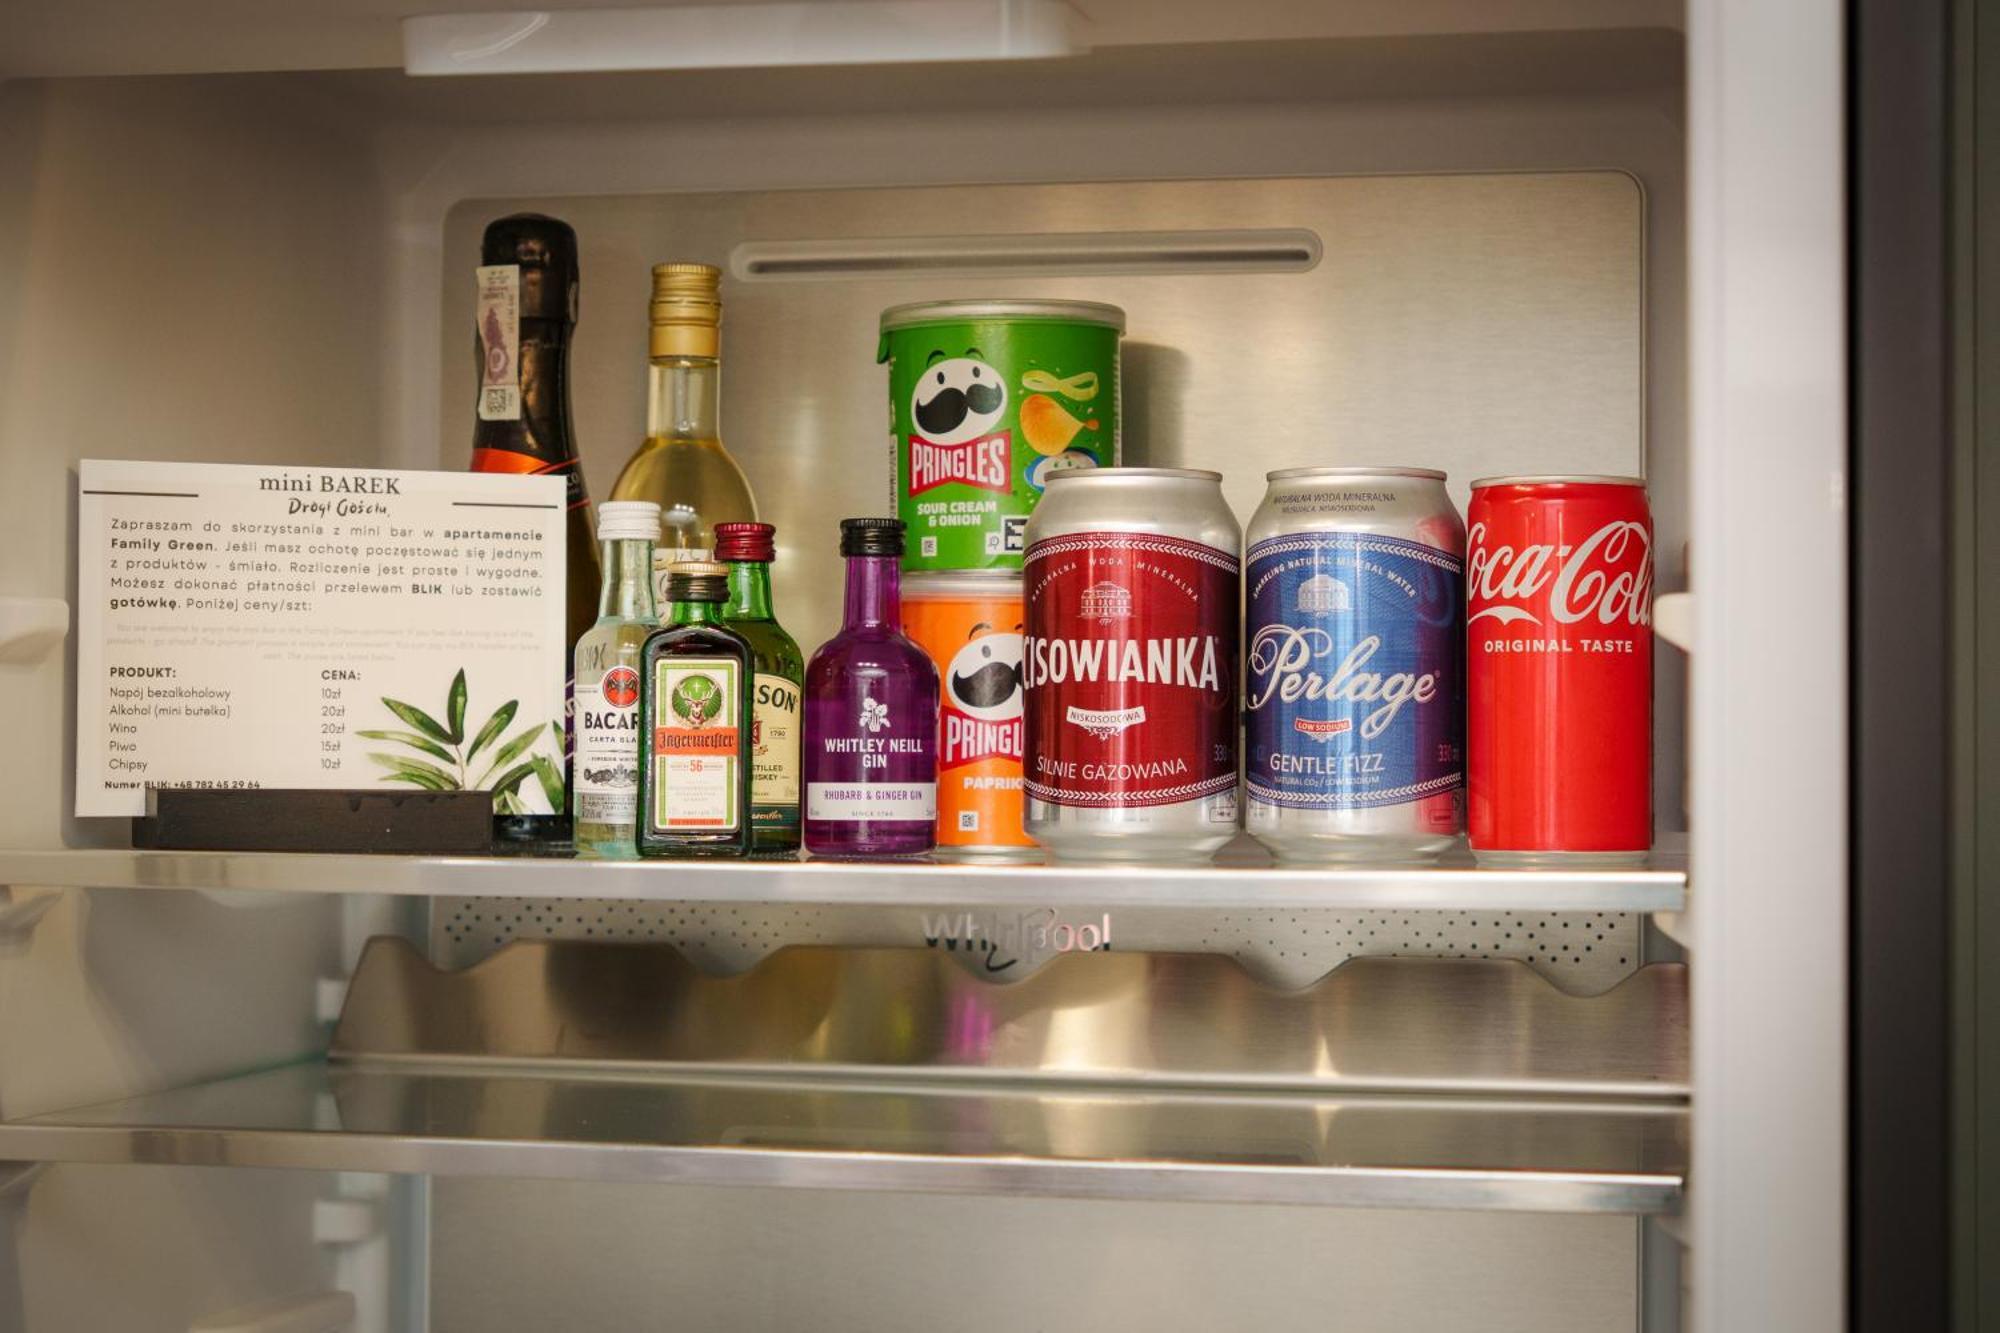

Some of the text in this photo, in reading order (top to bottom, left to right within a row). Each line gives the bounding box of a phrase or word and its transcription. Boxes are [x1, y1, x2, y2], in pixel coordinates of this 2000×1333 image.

[912, 437, 1004, 490] PRINGLES
[259, 474, 400, 494] mini BAREK
[1314, 493, 1340, 502] WODA
[1344, 492, 1396, 502] MINERALNA
[918, 500, 997, 515] SOUR CREAM
[928, 514, 981, 526] & ONION
[111, 518, 192, 533] Zapraszam
[203, 522, 221, 532] do
[232, 522, 324, 536] skorzystania
[352, 524, 380, 536] mini
[391, 526, 415, 536] bar
[444, 528, 542, 541] apartamencie
[111, 538, 542, 560] Family Green. Jeśli masz ochotę poczęstować się jednym
[110, 560, 118, 569] z
[126, 558, 207, 573] produktów
[229, 560, 282, 572] śmiało.
[290, 562, 370, 574] Rozliczenie
[378, 562, 404, 577] jest
[412, 565, 458, 578] proste
[476, 568, 542, 580] wygodne.
[1136, 562, 1200, 602] MINERALNA
[1288, 557, 1332, 570] NATURAL
[1337, 557, 1383, 576] MINERAL
[1388, 570, 1416, 598] WATER
[111, 576, 542, 597] Możesz dokonać płatności przelewem BLIK lub zostawić
[110, 597, 312, 613] gotówkę. Poniżej ceny/szt:
[1484, 640, 1632, 652] ORIGINAL TASTE
[1023, 635, 1219, 691] CISOWIANKA
[110, 666, 176, 678] PRODUKT:
[321, 670, 360, 680] CENA:
[1247, 624, 1436, 740] Perlage
[110, 686, 230, 700] Napój bezalkoholowy
[322, 688, 341, 698] 10zł
[752, 684, 797, 714] SON
[110, 705, 230, 718] Alkohol (mini butelka)
[322, 706, 345, 716] 20zł
[1070, 711, 1140, 723] NISKOSODOWA
[109, 723, 137, 734] Wino
[322, 724, 345, 734] 20zł
[1298, 720, 1348, 732] LOW SODIUM
[110, 740, 136, 751] Piwo
[322, 740, 340, 751] 15zł
[825, 738, 922, 752] WHITLEY NEILL
[946, 715, 1022, 762] PRINGL
[109, 758, 148, 772] Chipsy
[322, 758, 340, 769] 10zł
[690, 760, 702, 772] 56
[862, 754, 887, 768] GIN
[1037, 756, 1188, 780] SILNIE GAZOWANA
[1270, 753, 1385, 774] GENTLE FIZZ
[104, 780, 141, 790] Numer
[144, 780, 171, 789] BLIK:
[174, 780, 192, 789] +48
[217, 780, 228, 789] 45
[232, 780, 244, 789] 29
[964, 776, 1024, 790] PAPRIK
[824, 790, 922, 800] RHUBARB & GINGER GIN
[922, 909, 1111, 968] Whirlpool
